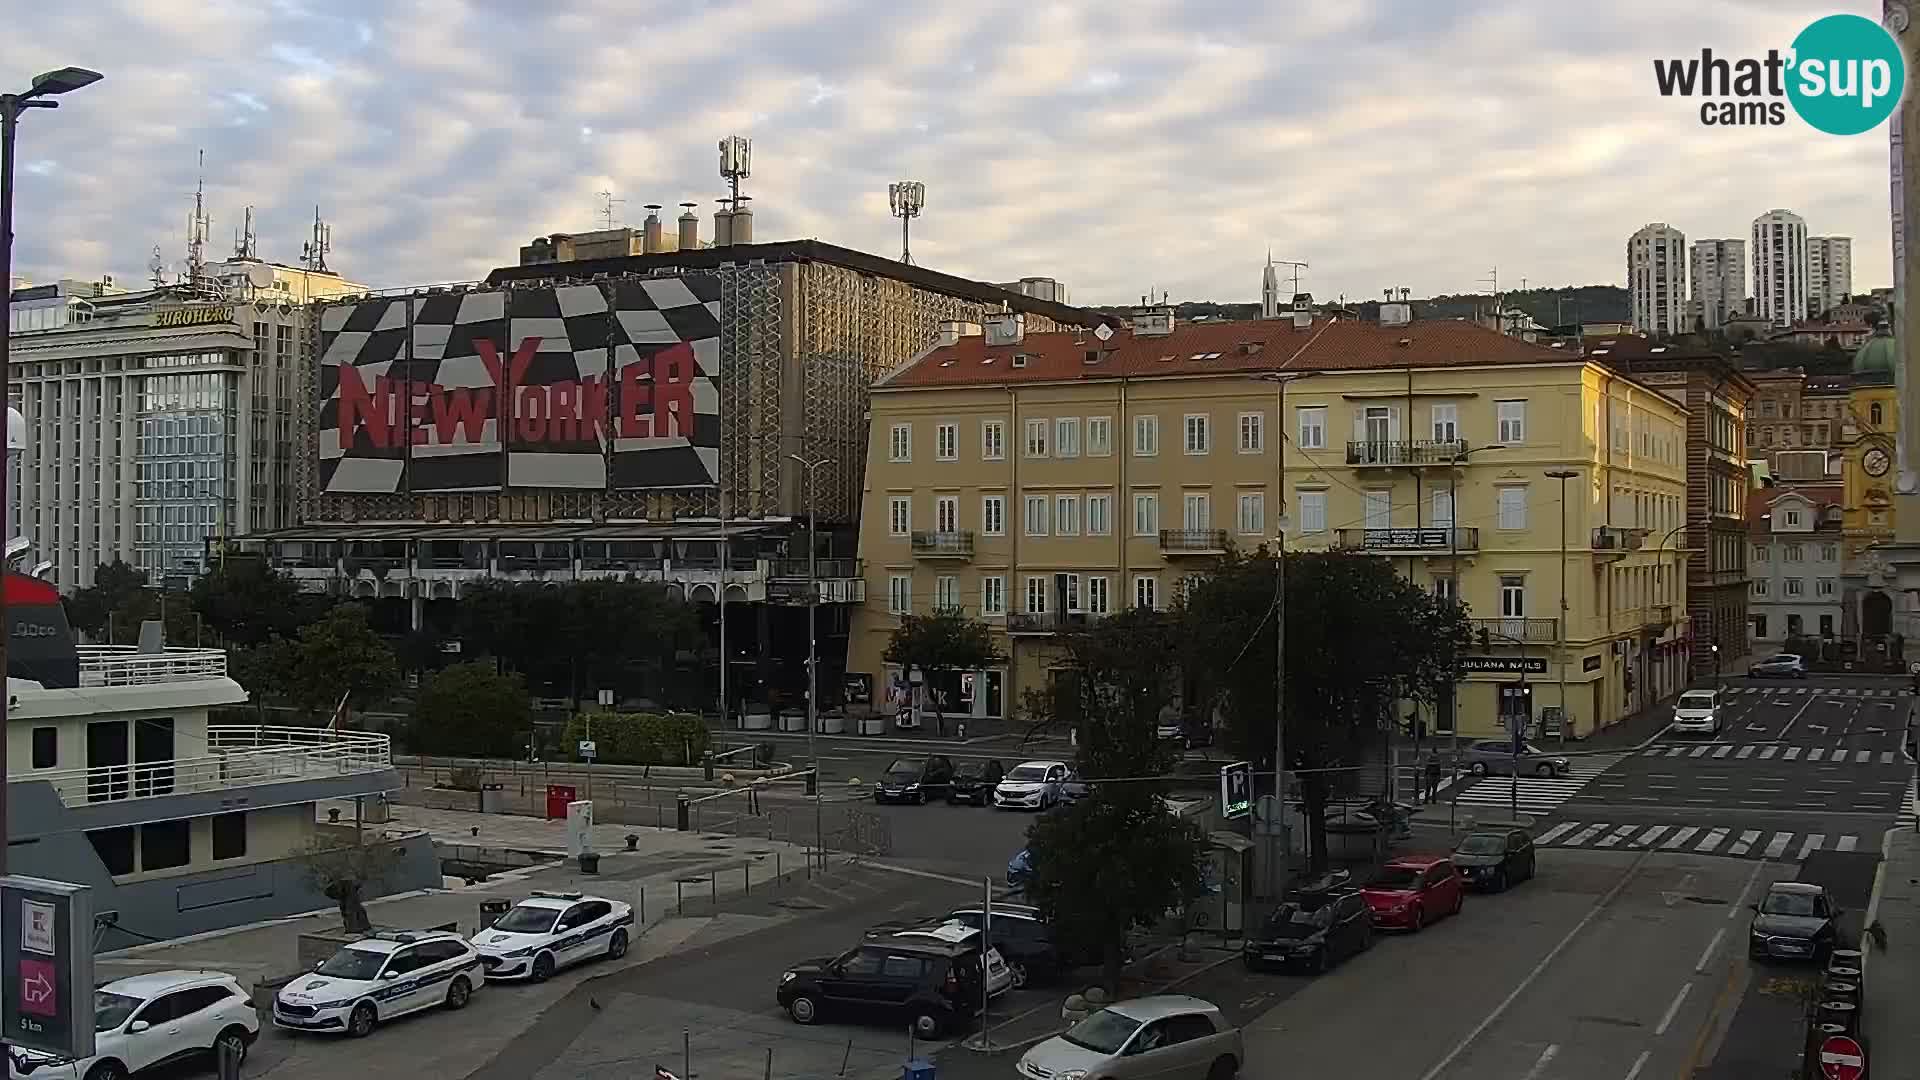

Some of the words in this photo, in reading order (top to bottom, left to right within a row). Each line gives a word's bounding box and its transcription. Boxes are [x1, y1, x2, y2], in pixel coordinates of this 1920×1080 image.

[1460, 661, 1505, 669] JULIANA
[20, 1018, 28, 1029] 5
[28, 1019, 43, 1032] km
